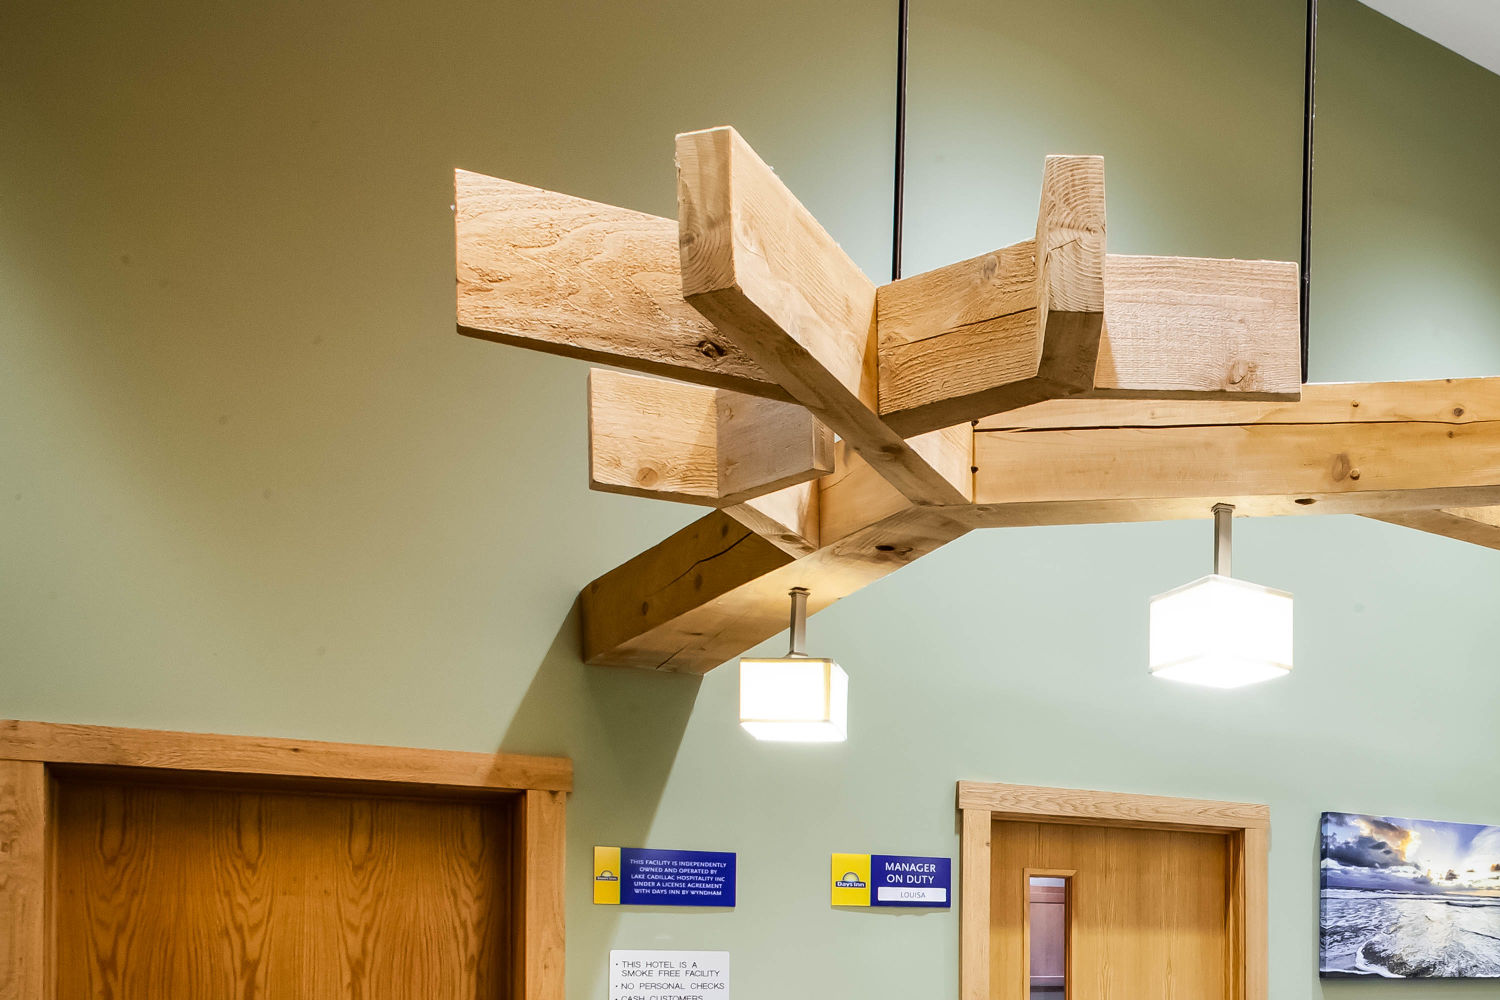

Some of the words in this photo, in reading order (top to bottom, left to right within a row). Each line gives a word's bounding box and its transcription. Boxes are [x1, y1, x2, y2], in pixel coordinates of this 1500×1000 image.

[885, 862, 936, 873] MANAGER
[886, 874, 903, 883] ON
[906, 874, 935, 884] DUTY
[900, 891, 926, 899] LOUISA
[622, 960, 641, 968] THIS
[621, 969, 654, 977] SMOKE
[620, 982, 635, 990] NO
[639, 982, 686, 990] PERSONAL
[690, 982, 725, 990] CHECKS
